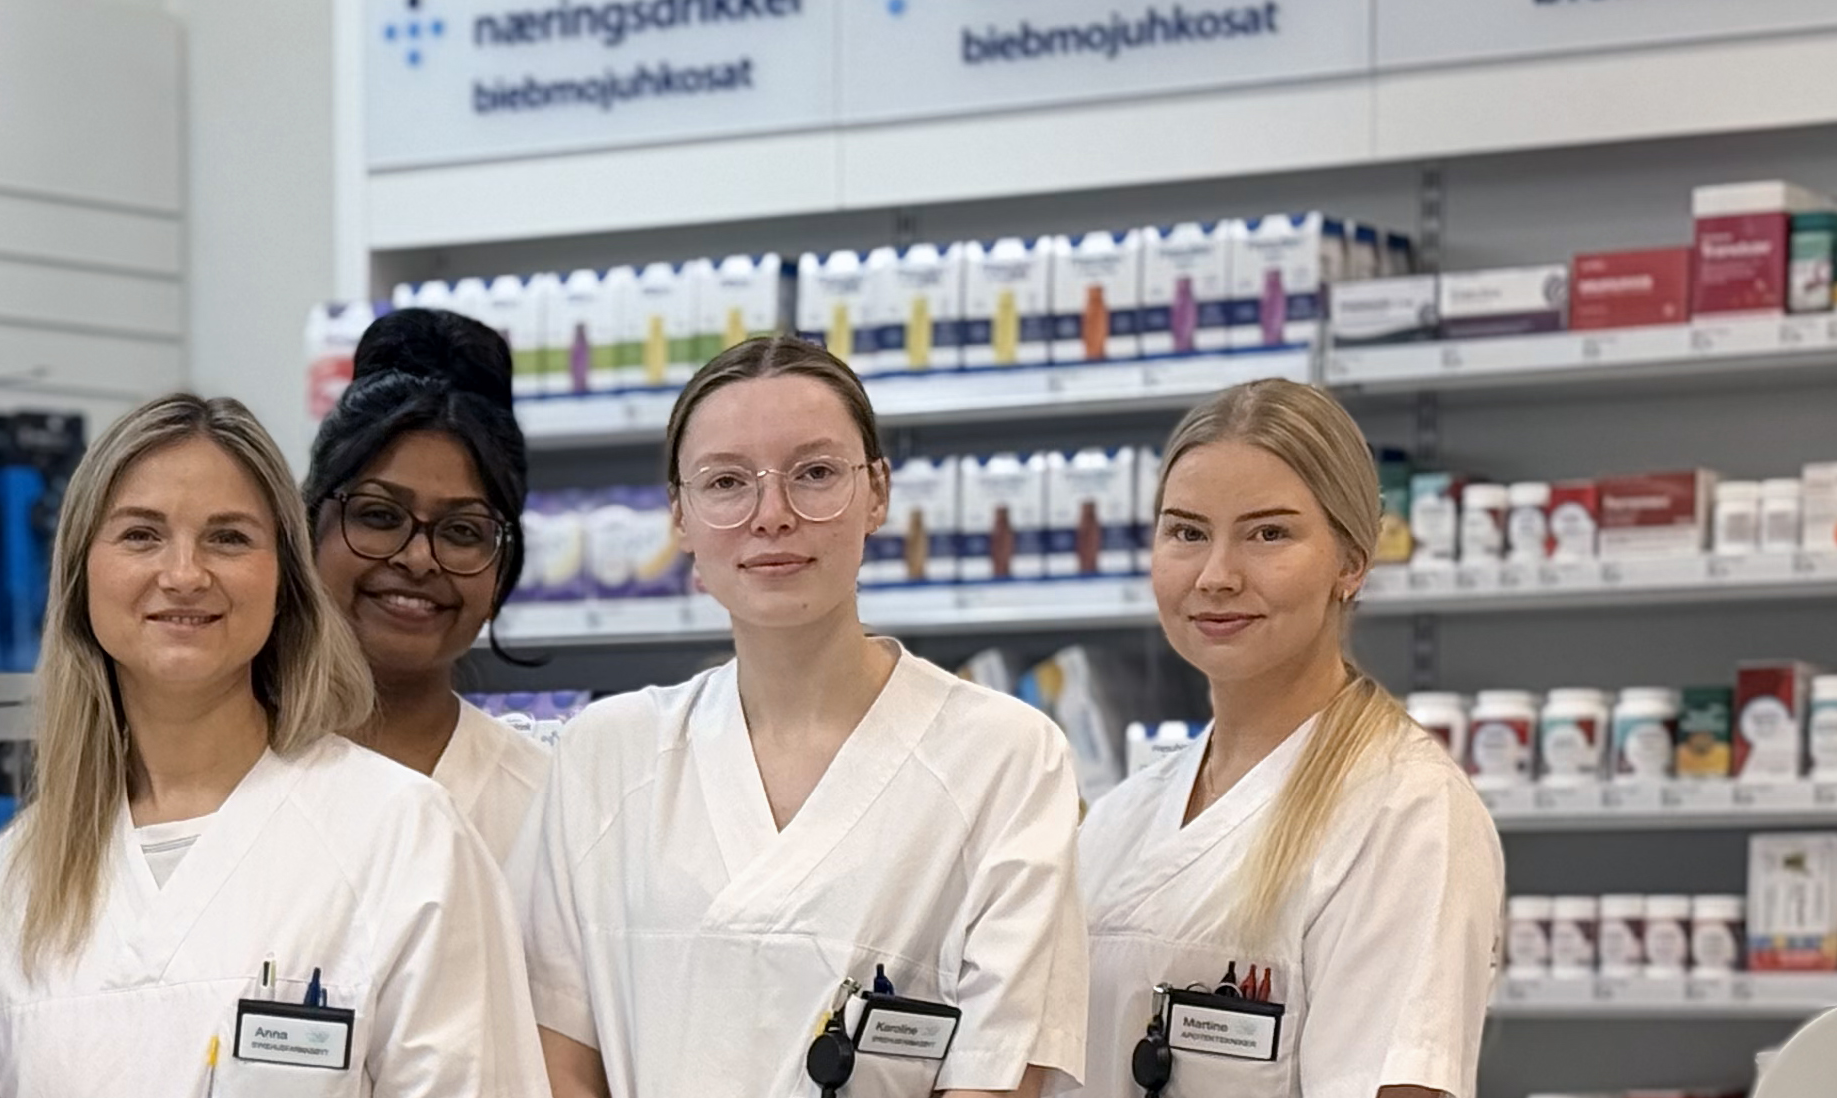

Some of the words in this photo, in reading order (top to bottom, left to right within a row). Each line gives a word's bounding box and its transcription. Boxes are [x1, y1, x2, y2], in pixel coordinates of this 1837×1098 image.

[961, 2, 1279, 63] biebmojuhkosat
[473, 56, 755, 114] biebmojuhkosat
[255, 1026, 289, 1040] Anna
[875, 1021, 919, 1036] Karoline
[1182, 1016, 1229, 1033] Martine
